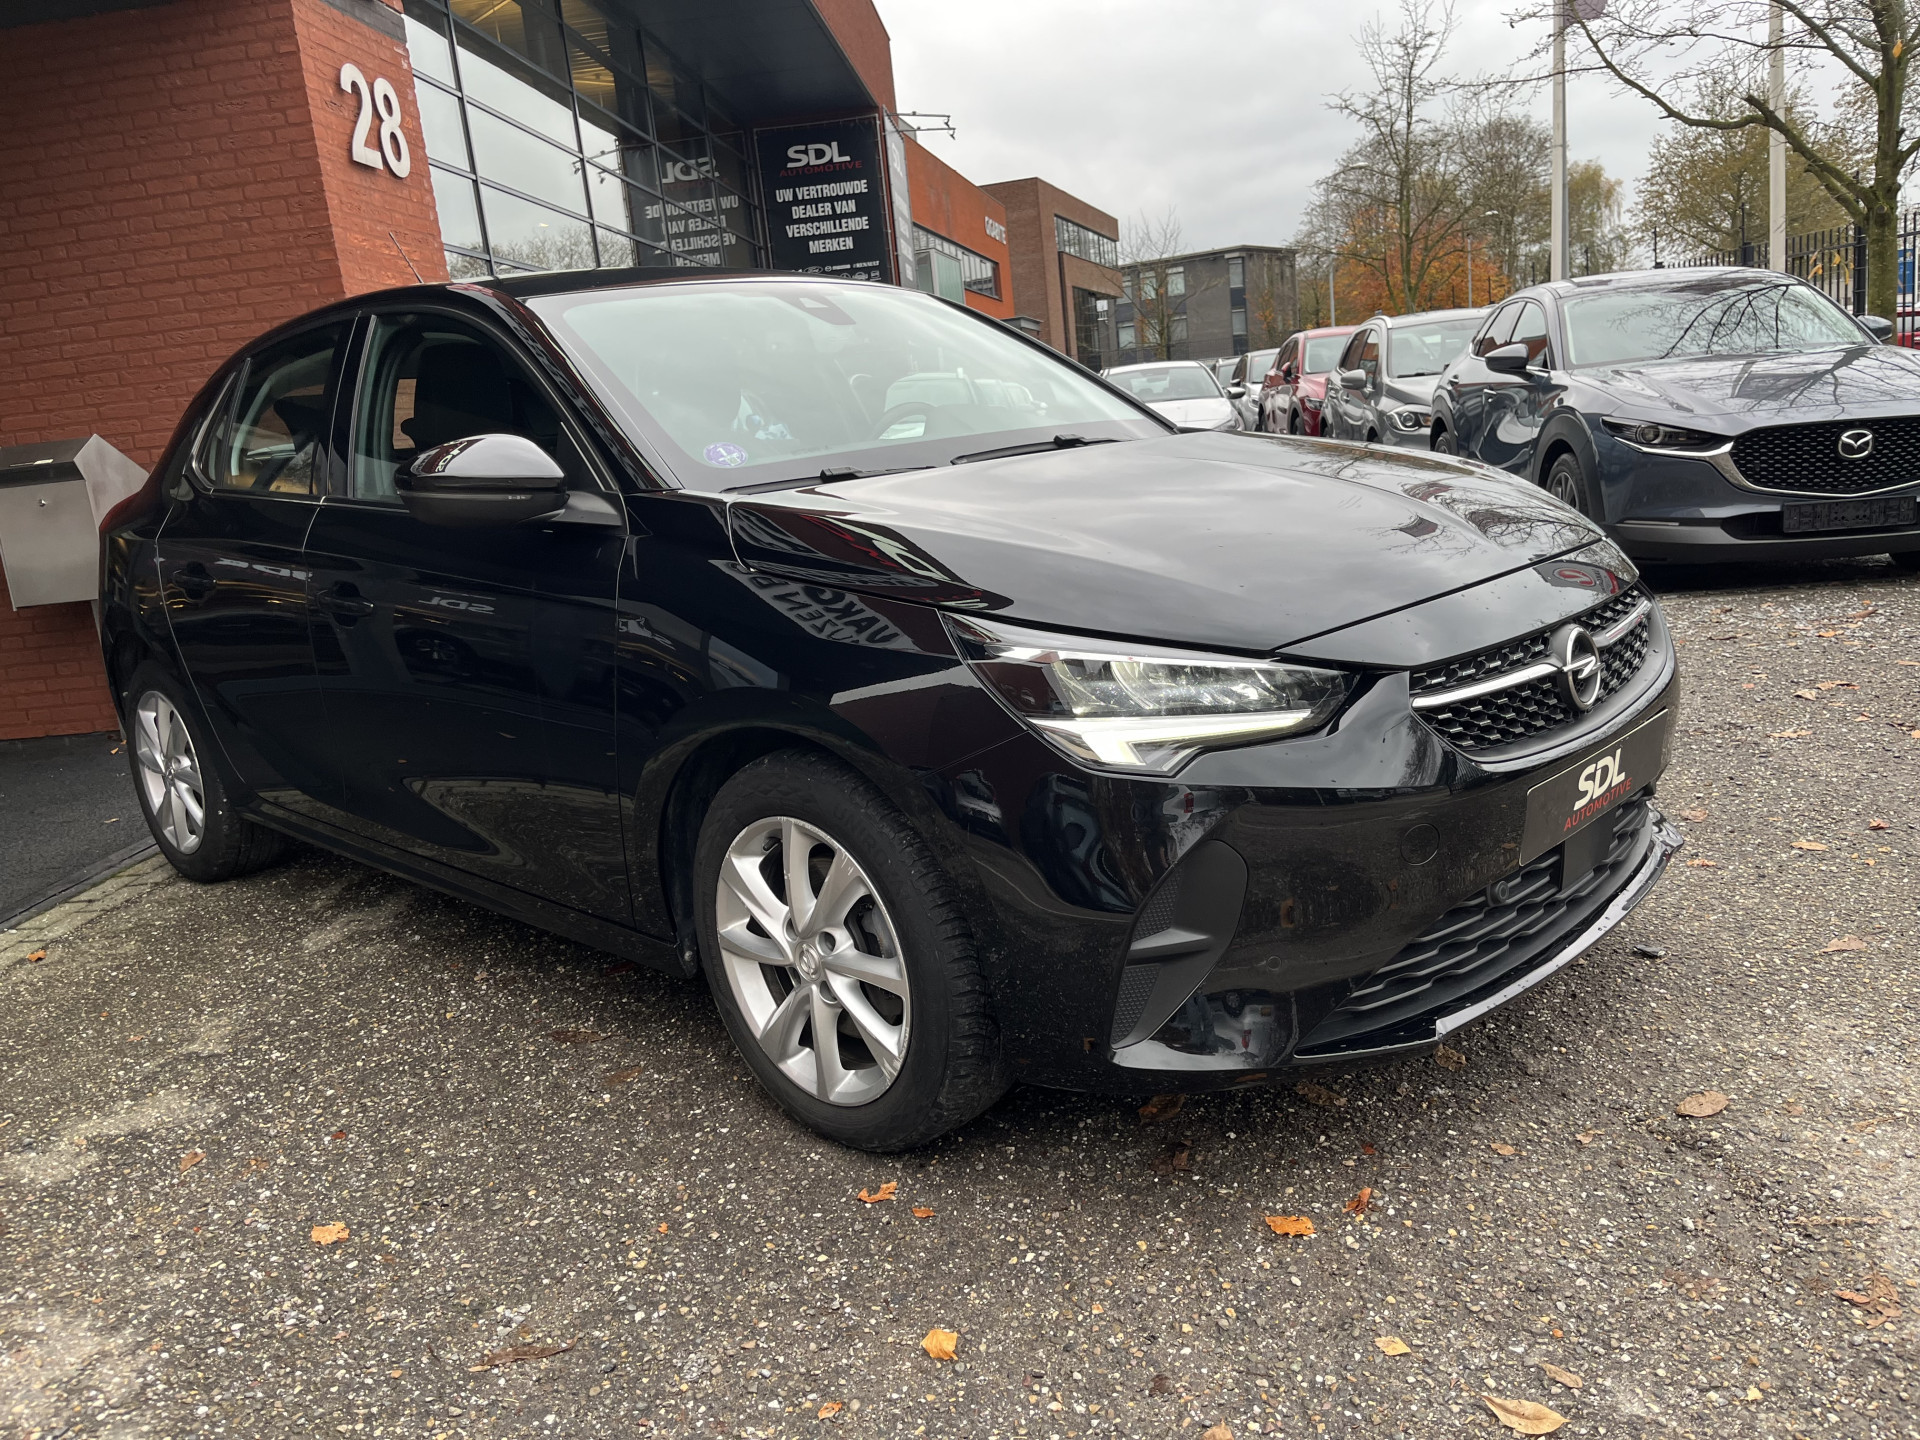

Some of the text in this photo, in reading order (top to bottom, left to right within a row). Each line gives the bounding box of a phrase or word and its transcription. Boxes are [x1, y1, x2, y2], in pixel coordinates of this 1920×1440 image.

[340, 63, 411, 178] 28
[786, 141, 851, 168] SDL
[780, 160, 863, 177] AUTOMOTIVE
[775, 180, 869, 203] UW VERTROUWDE
[791, 199, 857, 220] DEALER VAN
[785, 216, 870, 238] VERSCHILLENDE
[808, 236, 854, 254] MERKEN
[1573, 748, 1626, 811] SDL
[1563, 777, 1633, 832] AUTOMOTIVE
